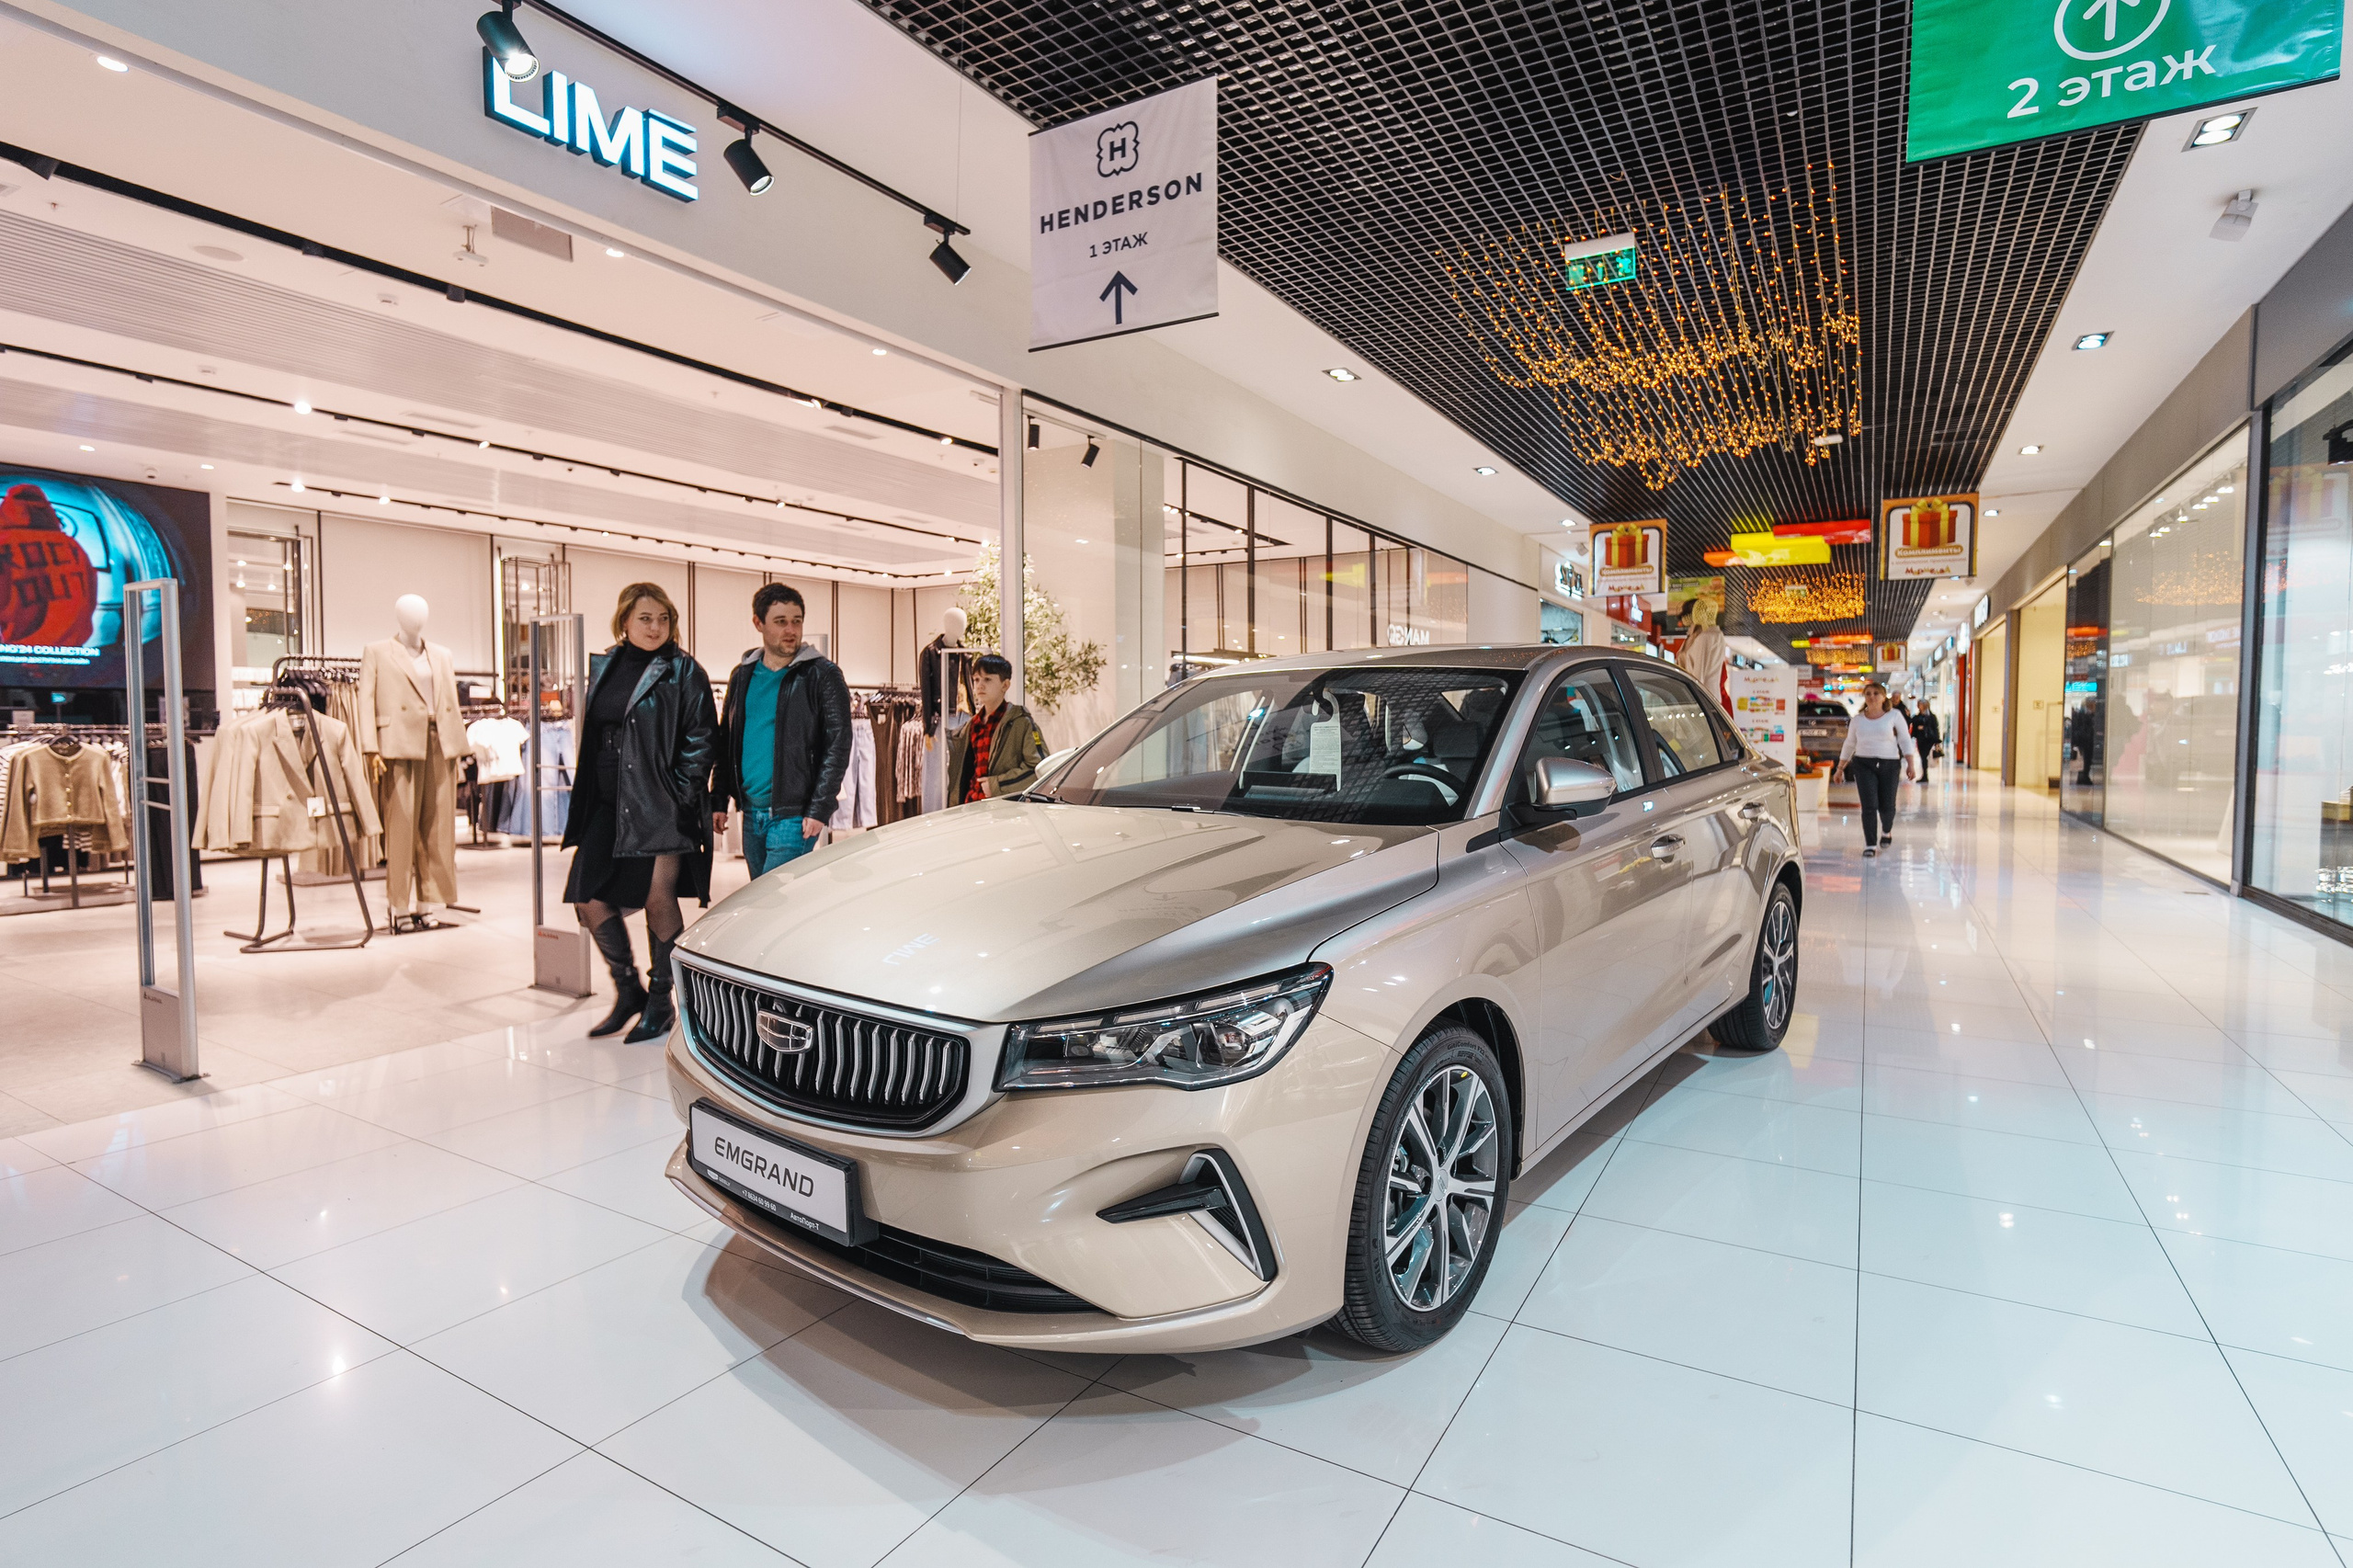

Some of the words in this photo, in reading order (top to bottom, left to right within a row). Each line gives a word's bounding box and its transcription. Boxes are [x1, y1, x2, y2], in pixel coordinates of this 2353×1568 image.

[2006, 77, 2040, 119] 2
[2057, 44, 2216, 107] этаж
[1108, 137, 1127, 162] H
[1040, 173, 1202, 234] HENDERSON
[1089, 244, 1097, 258] 1
[1102, 232, 1149, 255] ЭТАЖ
[1896, 547, 1961, 557] Комплименты
[33, 645, 100, 656] COLLECTION
[714, 1136, 814, 1198] EMGRAND
